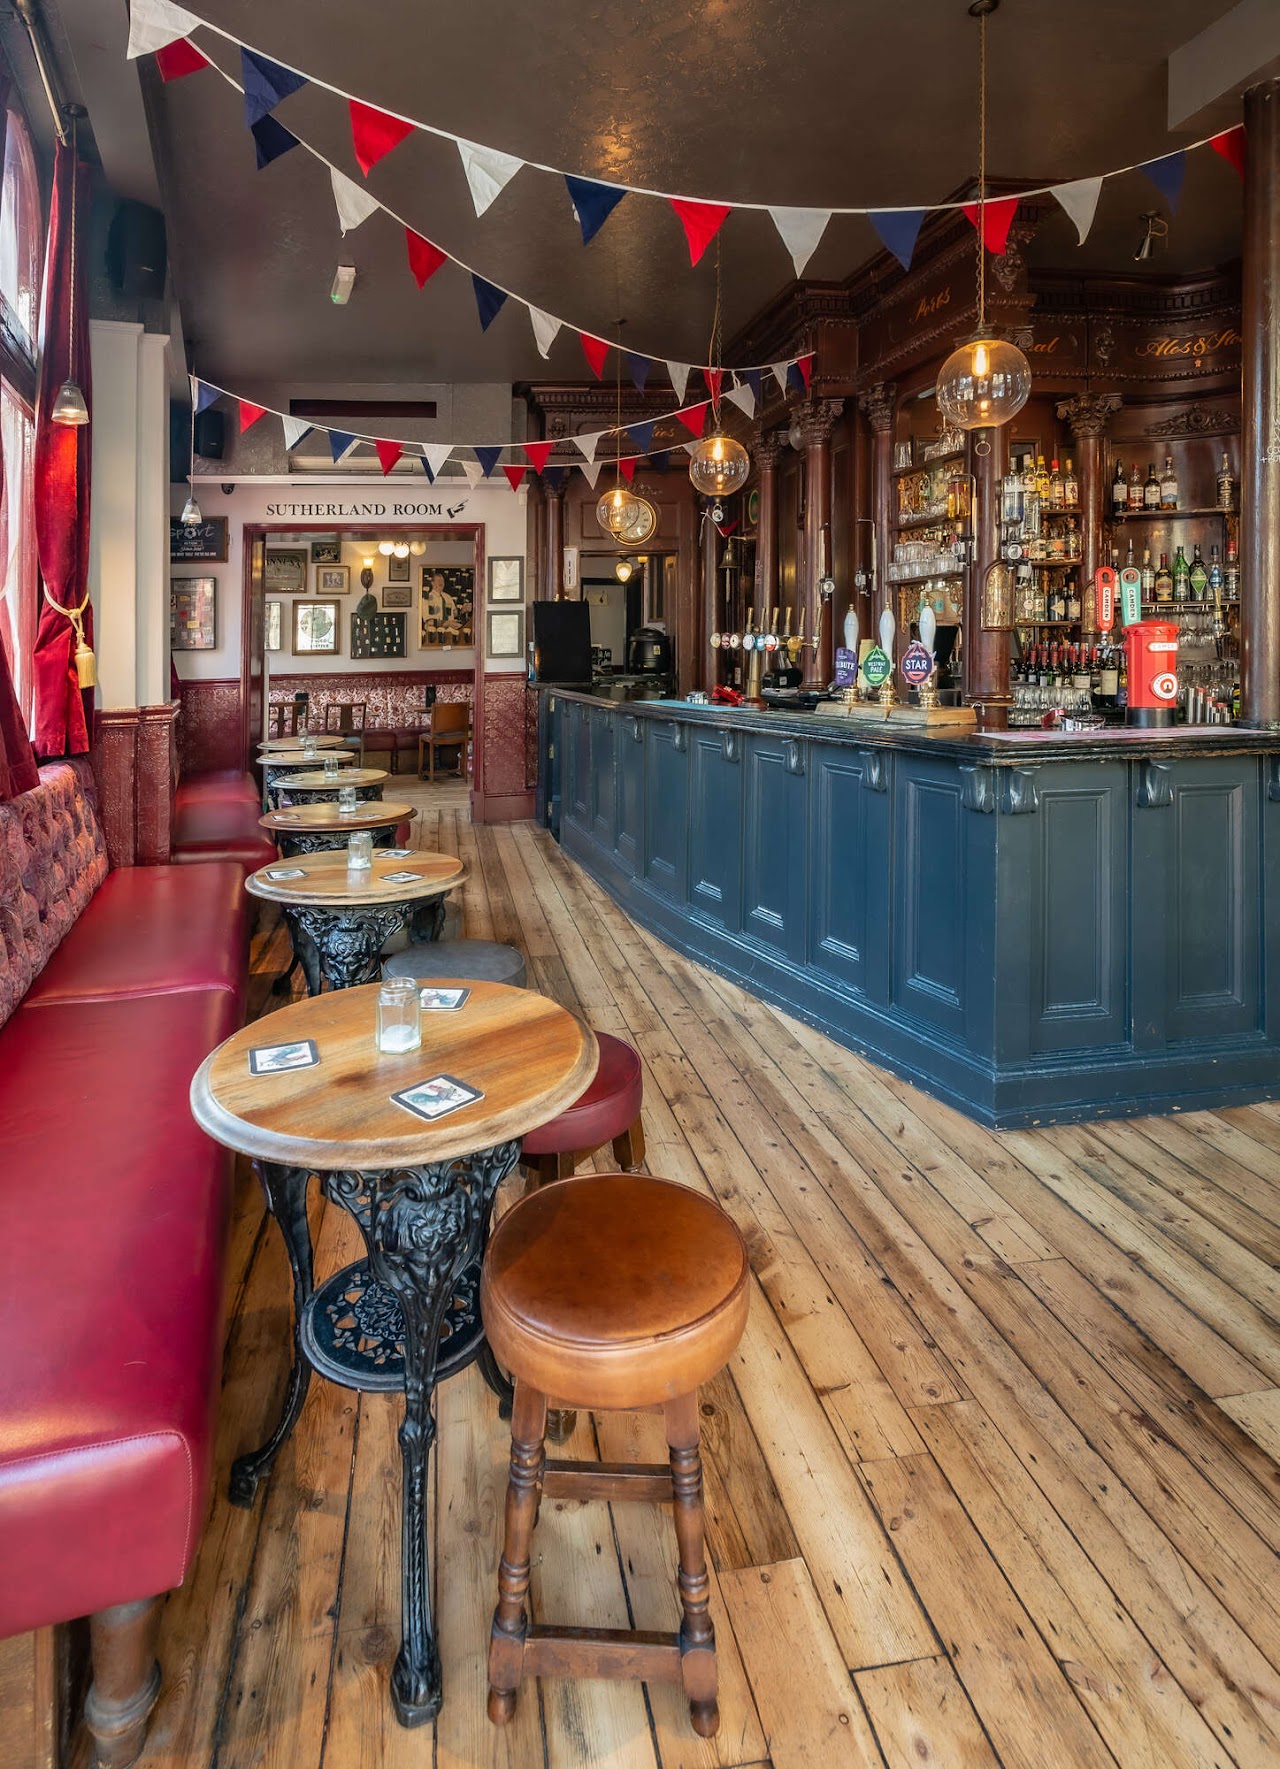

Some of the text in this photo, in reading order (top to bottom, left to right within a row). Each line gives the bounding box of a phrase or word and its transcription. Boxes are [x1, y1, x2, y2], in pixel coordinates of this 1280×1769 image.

[1135, 337, 1193, 357] Ales
[266, 503, 443, 516] SUTHERLAND ROOM
[905, 659, 928, 670] STAR
